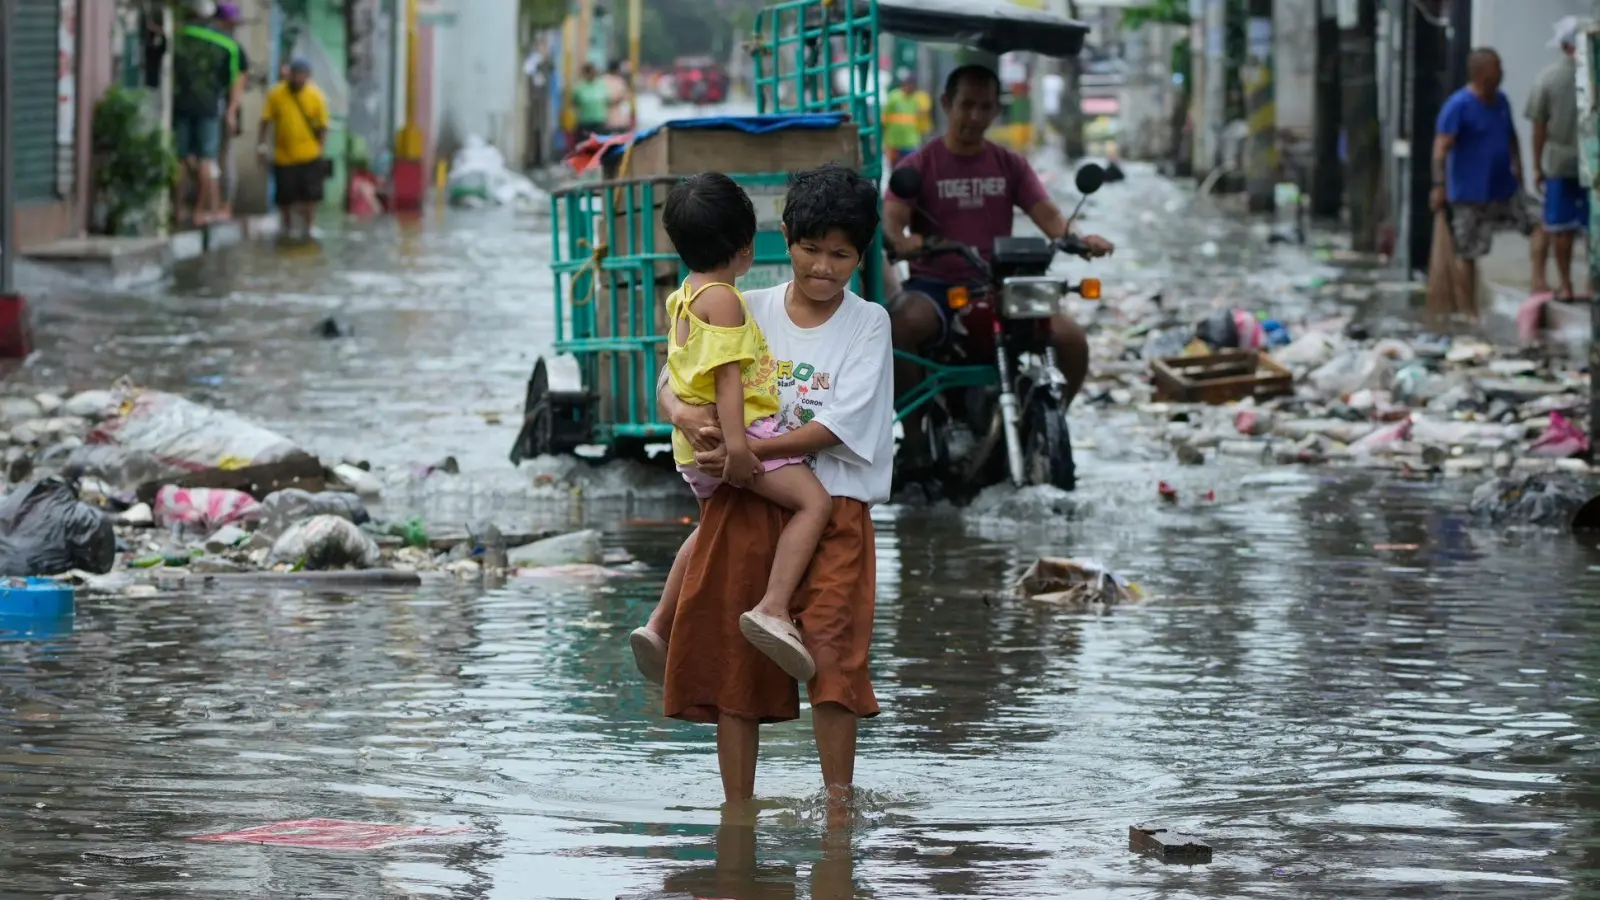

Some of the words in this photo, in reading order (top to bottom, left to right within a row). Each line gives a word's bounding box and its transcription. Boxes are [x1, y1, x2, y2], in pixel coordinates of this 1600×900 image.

[937, 177, 1006, 199] TOGETHER
[777, 360, 830, 390] RON
[777, 379, 795, 387] sland
[801, 399, 823, 407] CORON
